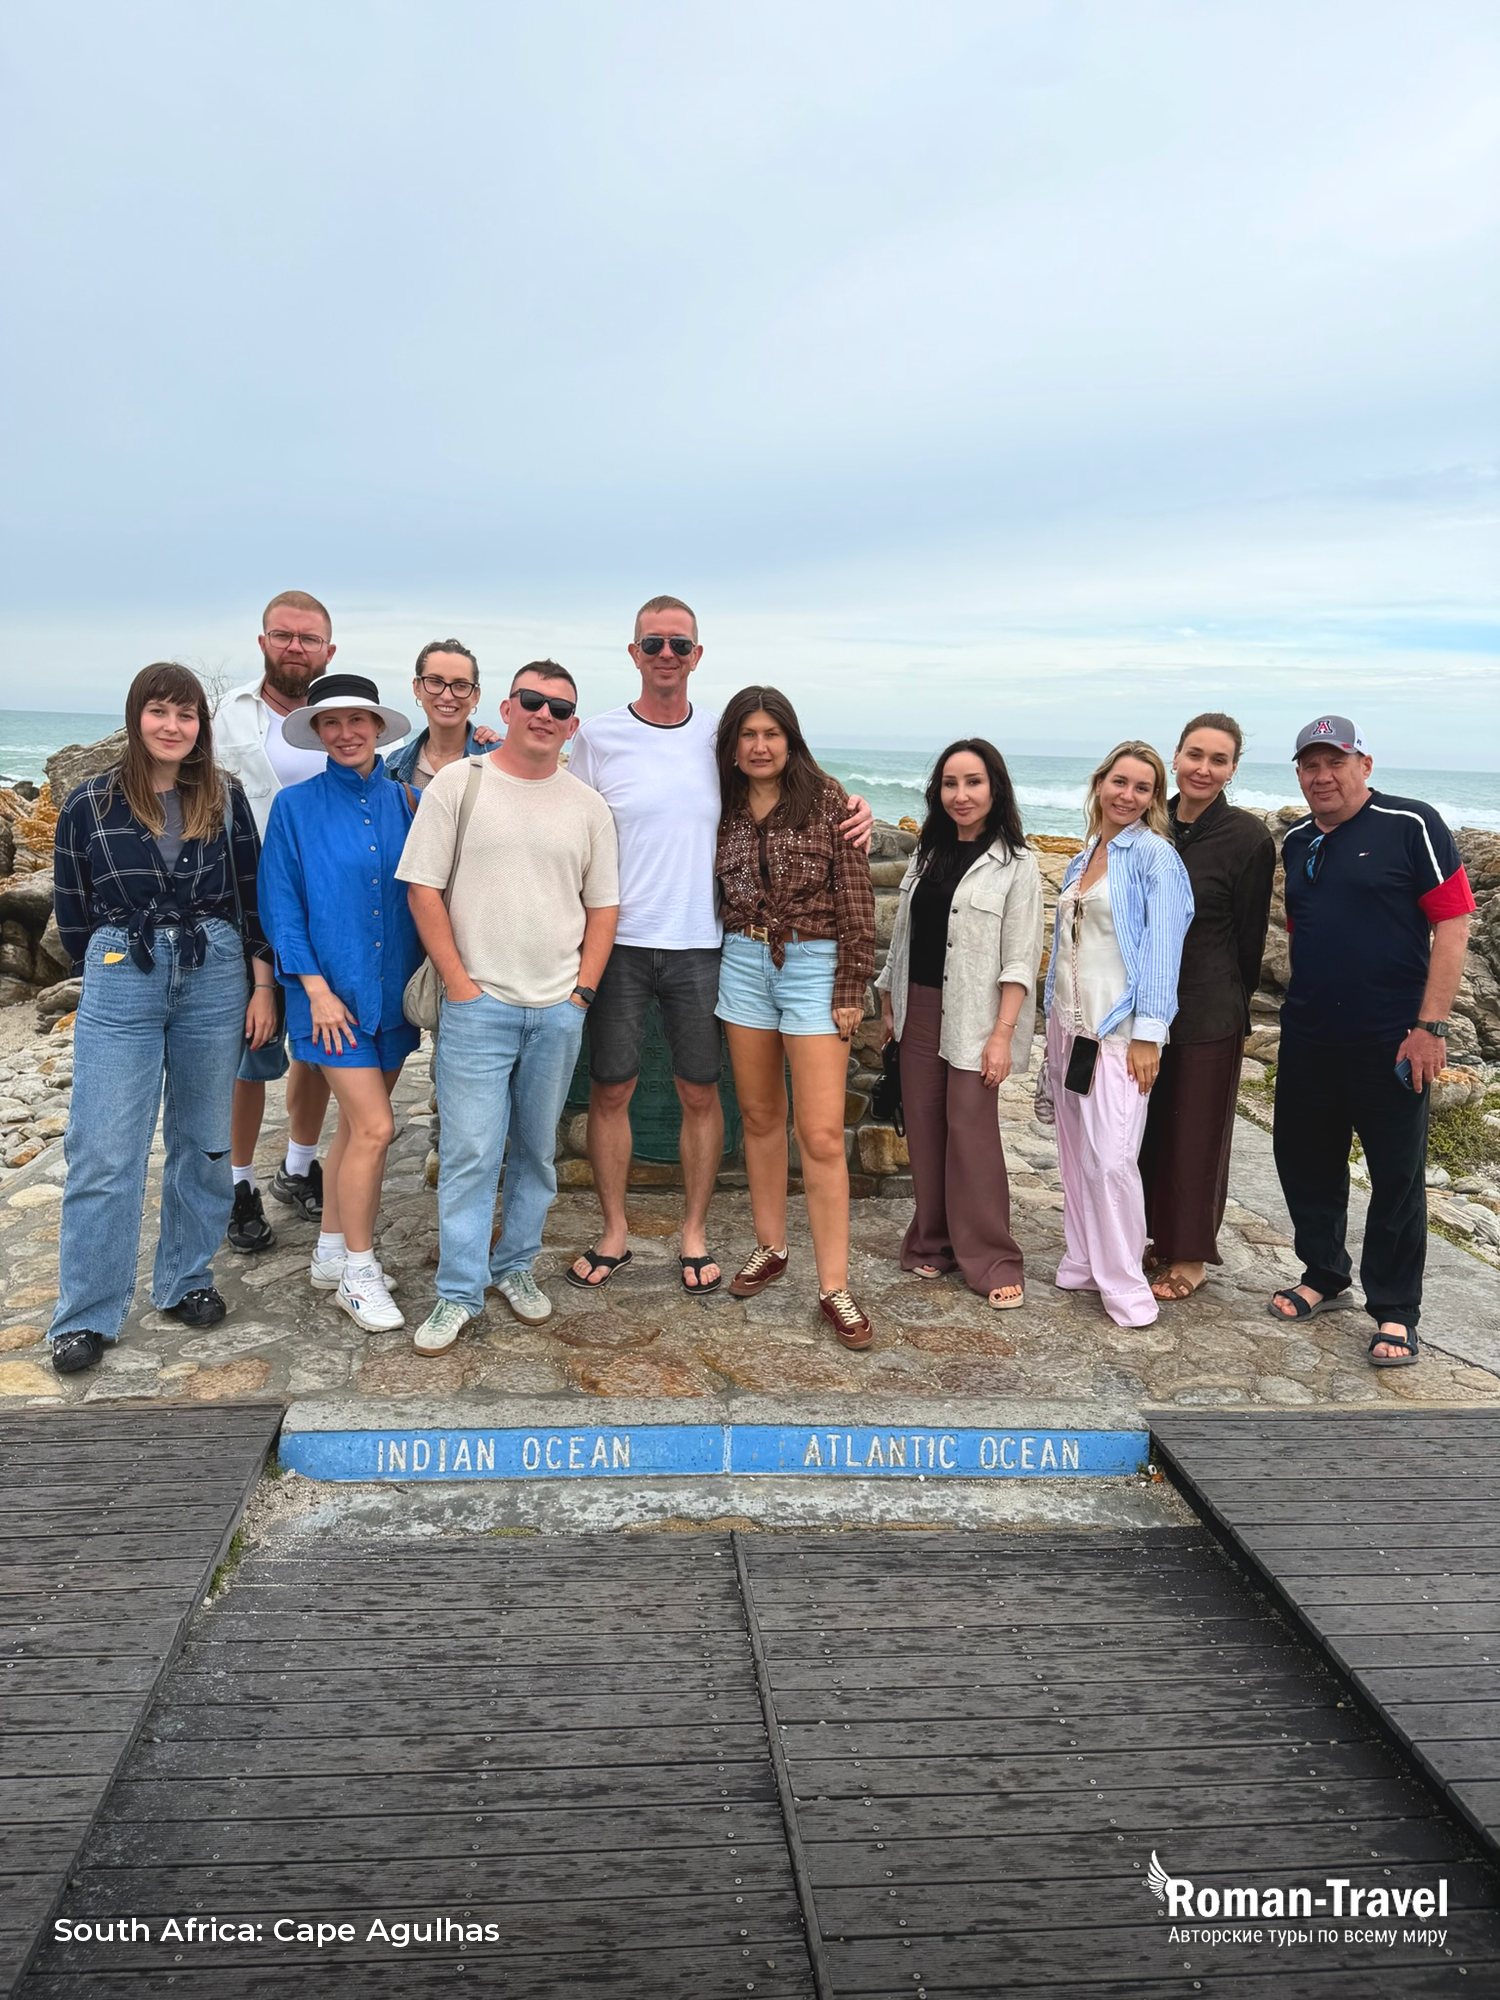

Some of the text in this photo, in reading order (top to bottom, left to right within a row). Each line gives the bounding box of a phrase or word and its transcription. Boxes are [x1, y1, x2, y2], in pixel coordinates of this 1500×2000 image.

[1311, 719, 1334, 736] A
[377, 1435, 631, 1472] INDIAN OCEAN
[803, 1434, 1080, 1470] ATLANTIC OCEAN
